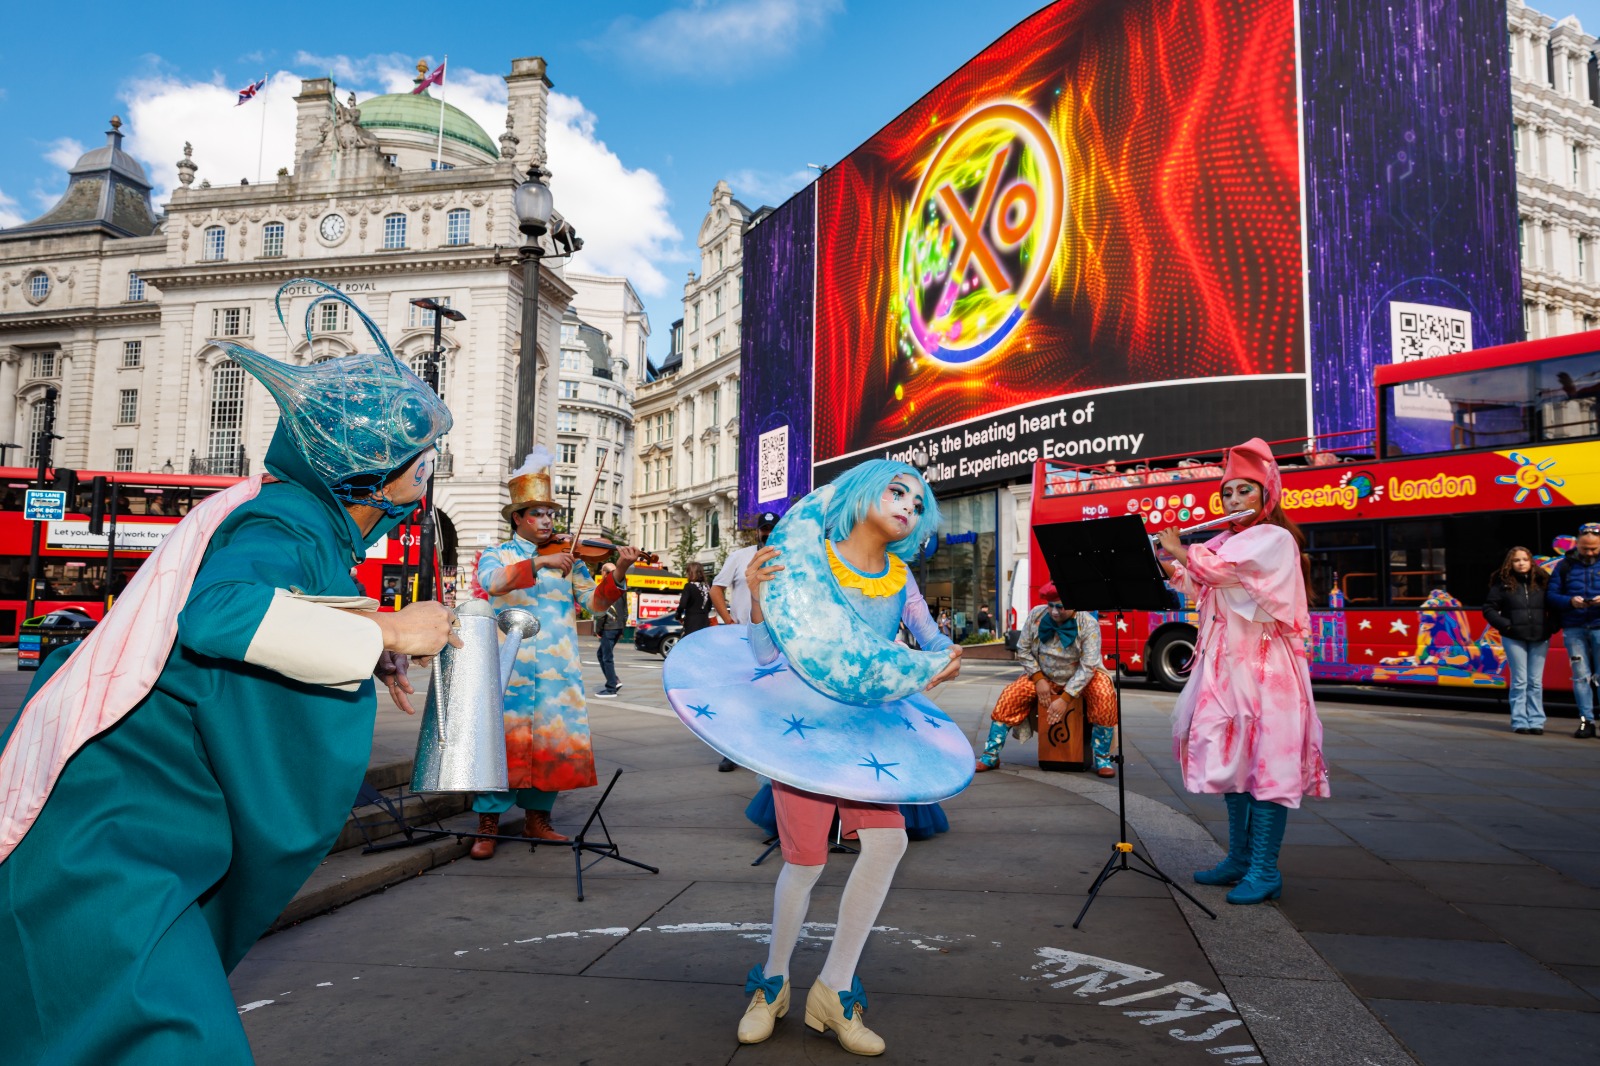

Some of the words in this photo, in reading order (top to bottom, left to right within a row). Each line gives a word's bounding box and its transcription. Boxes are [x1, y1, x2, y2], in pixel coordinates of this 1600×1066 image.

[282, 286, 312, 295] HOTEL
[316, 282, 342, 294] CAÉ
[345, 282, 377, 292] ROYAL
[886, 444, 927, 465] ondo
[928, 438, 940, 457] is
[940, 434, 962, 454] the
[964, 421, 1016, 442] beating
[1019, 408, 1067, 435] heart
[1071, 401, 1095, 425] of
[922, 462, 957, 483] dlar
[959, 449, 1038, 478] Experience
[1043, 432, 1144, 459] Economy
[1389, 472, 1476, 501] London
[1082, 505, 1097, 516] Hop
[1097, 504, 1109, 515] On
[54, 528, 69, 536] Let
[70, 530, 90, 538] your
[147, 531, 159, 539] for
